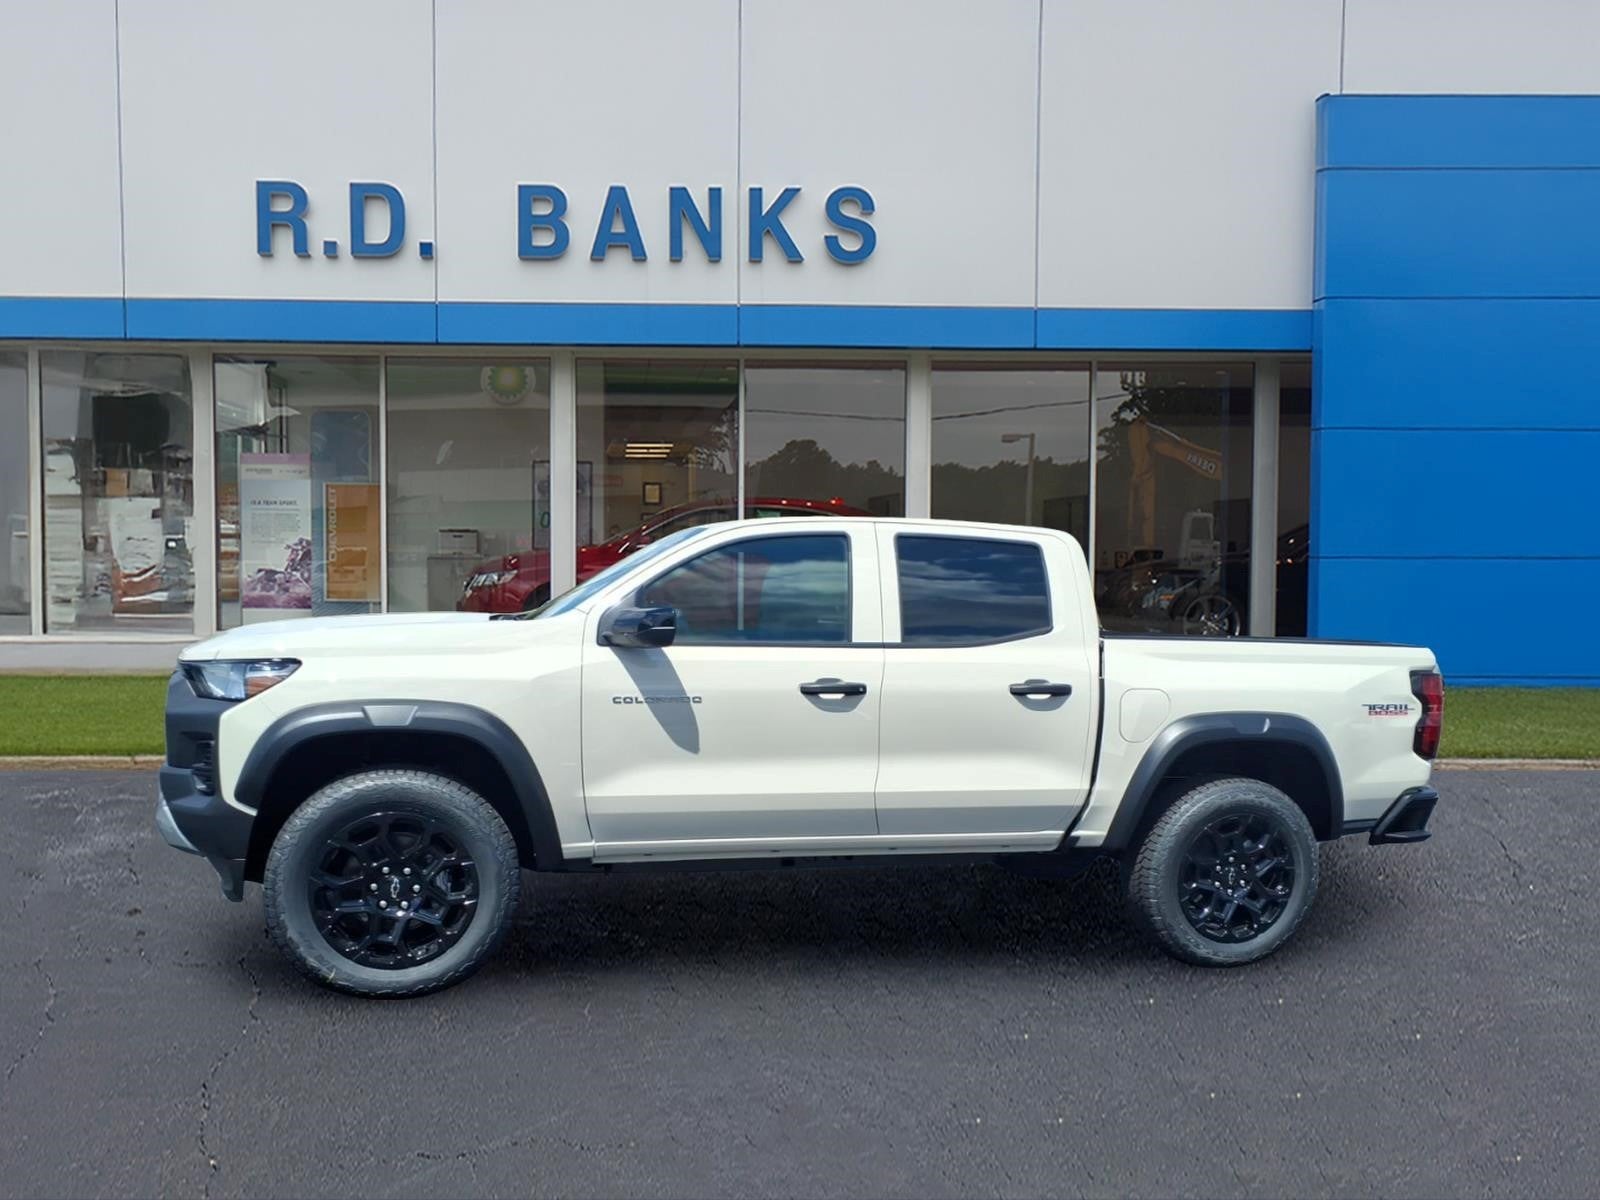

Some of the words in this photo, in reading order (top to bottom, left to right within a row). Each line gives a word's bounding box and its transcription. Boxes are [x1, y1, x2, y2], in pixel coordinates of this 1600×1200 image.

[256, 181, 434, 257] R.D.
[517, 184, 877, 264] BANKS
[328, 487, 337, 562] CHEVROLET
